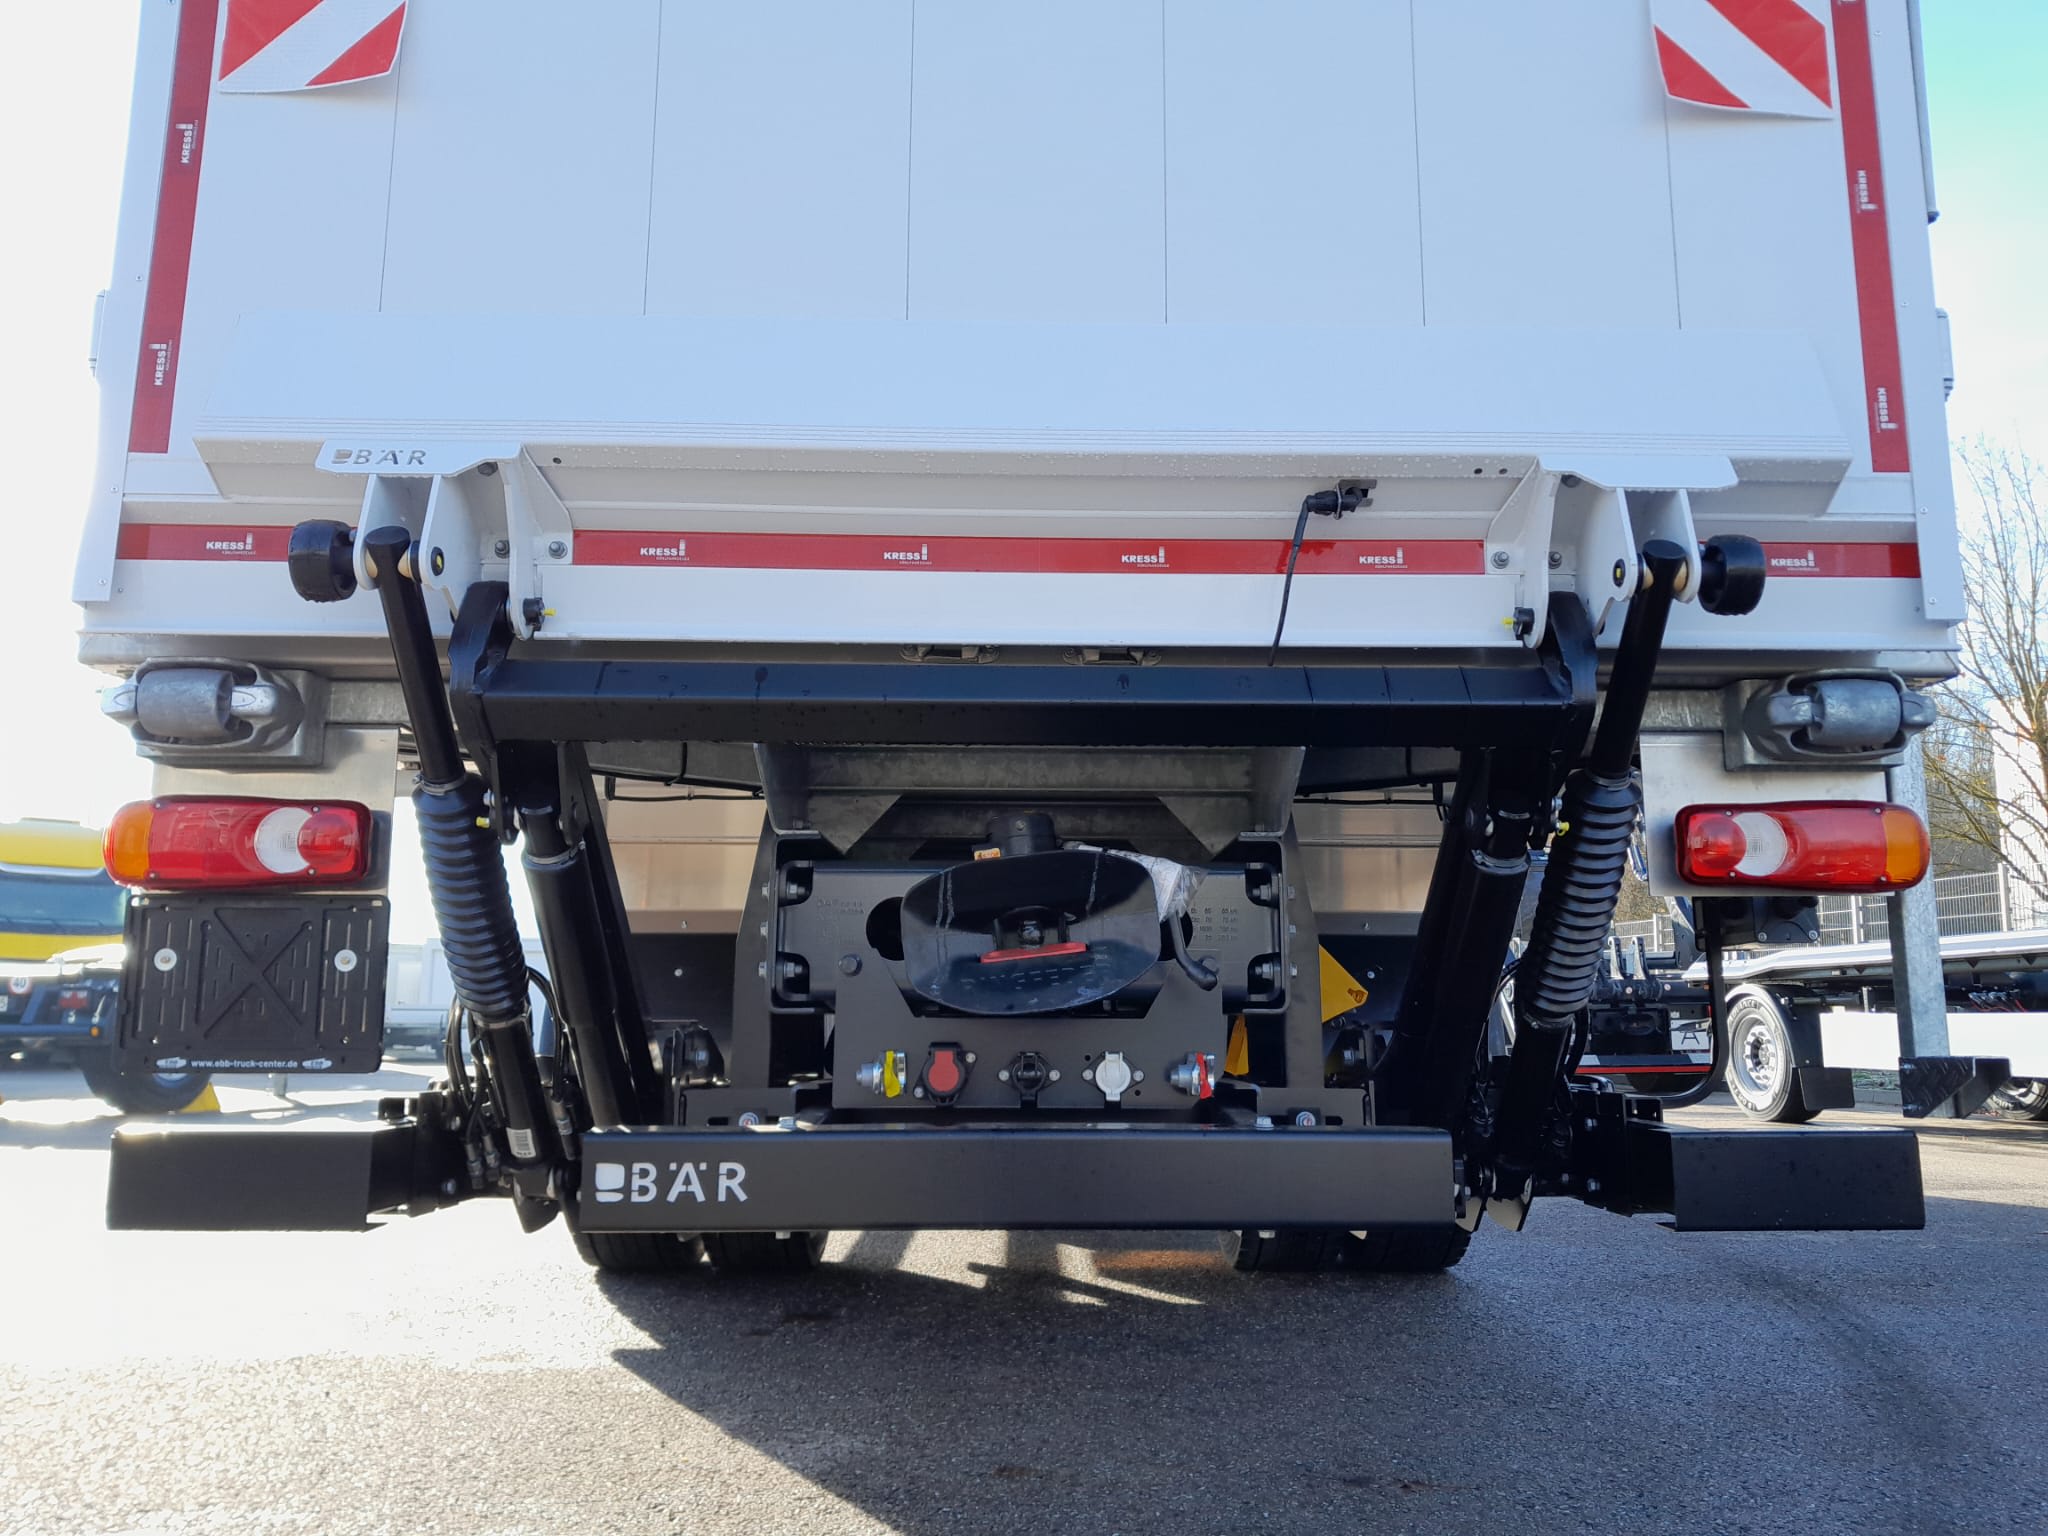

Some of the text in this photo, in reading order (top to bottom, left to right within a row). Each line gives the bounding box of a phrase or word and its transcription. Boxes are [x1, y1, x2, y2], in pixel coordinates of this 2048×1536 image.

[180, 130, 193, 163] KRESS
[154, 350, 167, 386] KRESS
[353, 448, 427, 465] BÄR
[206, 541, 245, 550] KRESS
[640, 547, 678, 556] KRESS
[883, 551, 921, 560] KRESS
[1121, 554, 1158, 563] KRESS
[1359, 555, 1396, 564] KRESS
[1771, 558, 1808, 567] KRESS
[191, 1059, 298, 1069] www.ebb-truck-center.de
[630, 1162, 748, 1203] BÄR
